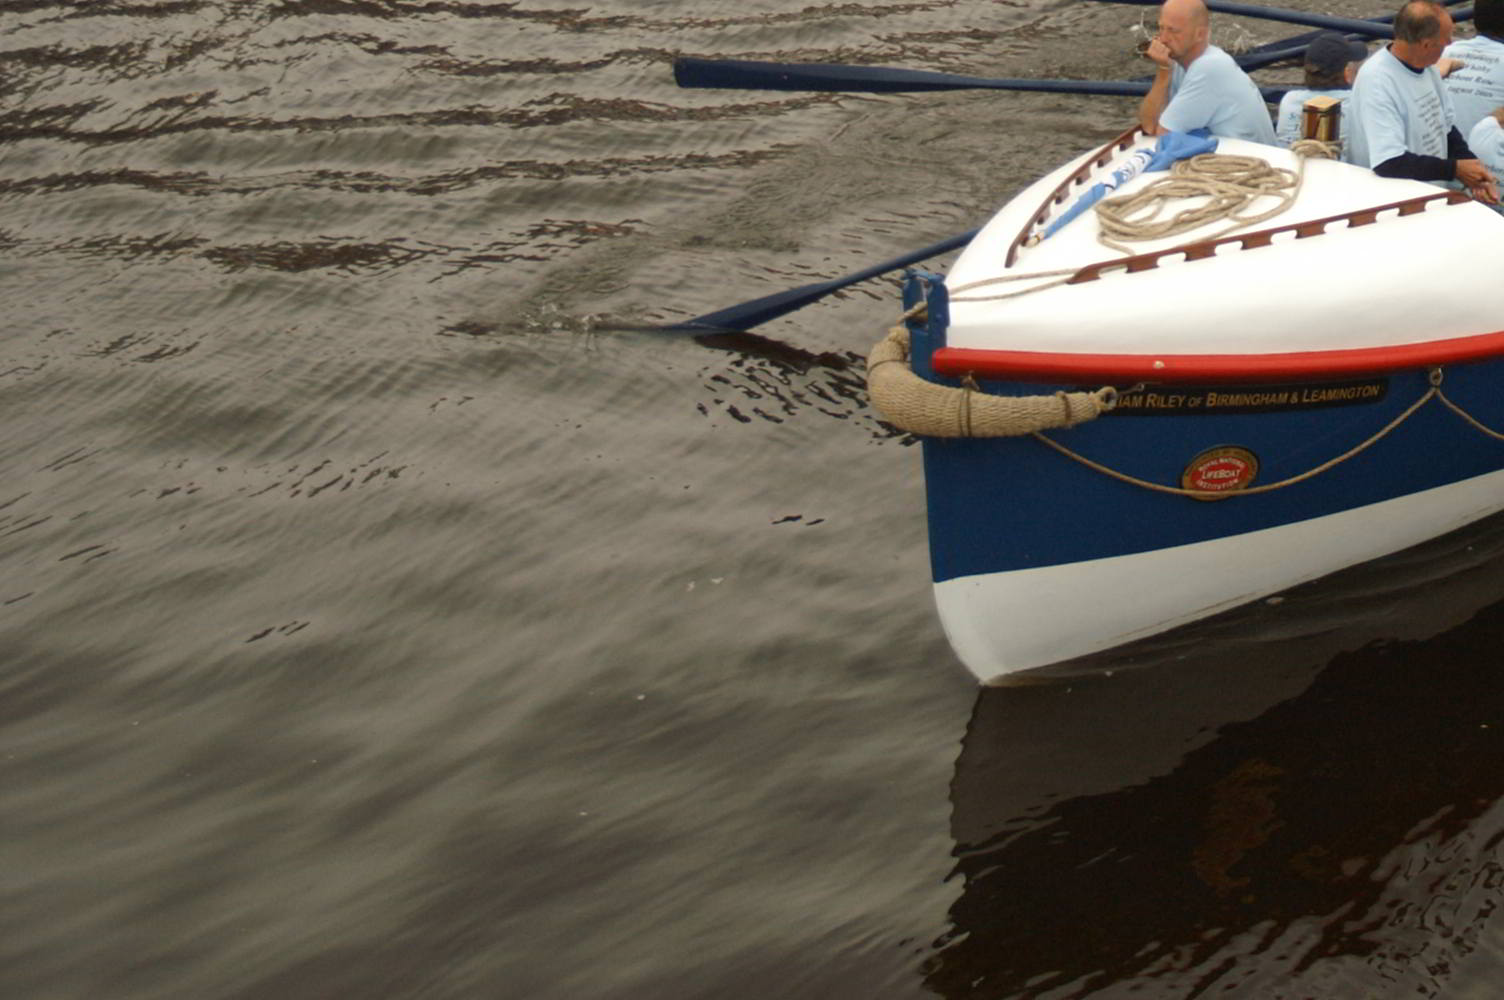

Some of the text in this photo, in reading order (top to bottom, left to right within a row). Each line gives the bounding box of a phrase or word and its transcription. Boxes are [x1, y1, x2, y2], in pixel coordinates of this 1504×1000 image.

[1146, 393, 1185, 408] RILEY
[1206, 392, 1288, 407] BIRMINGHAM
[1290, 391, 1299, 404] &
[1302, 385, 1380, 403] LEAMINGTON
